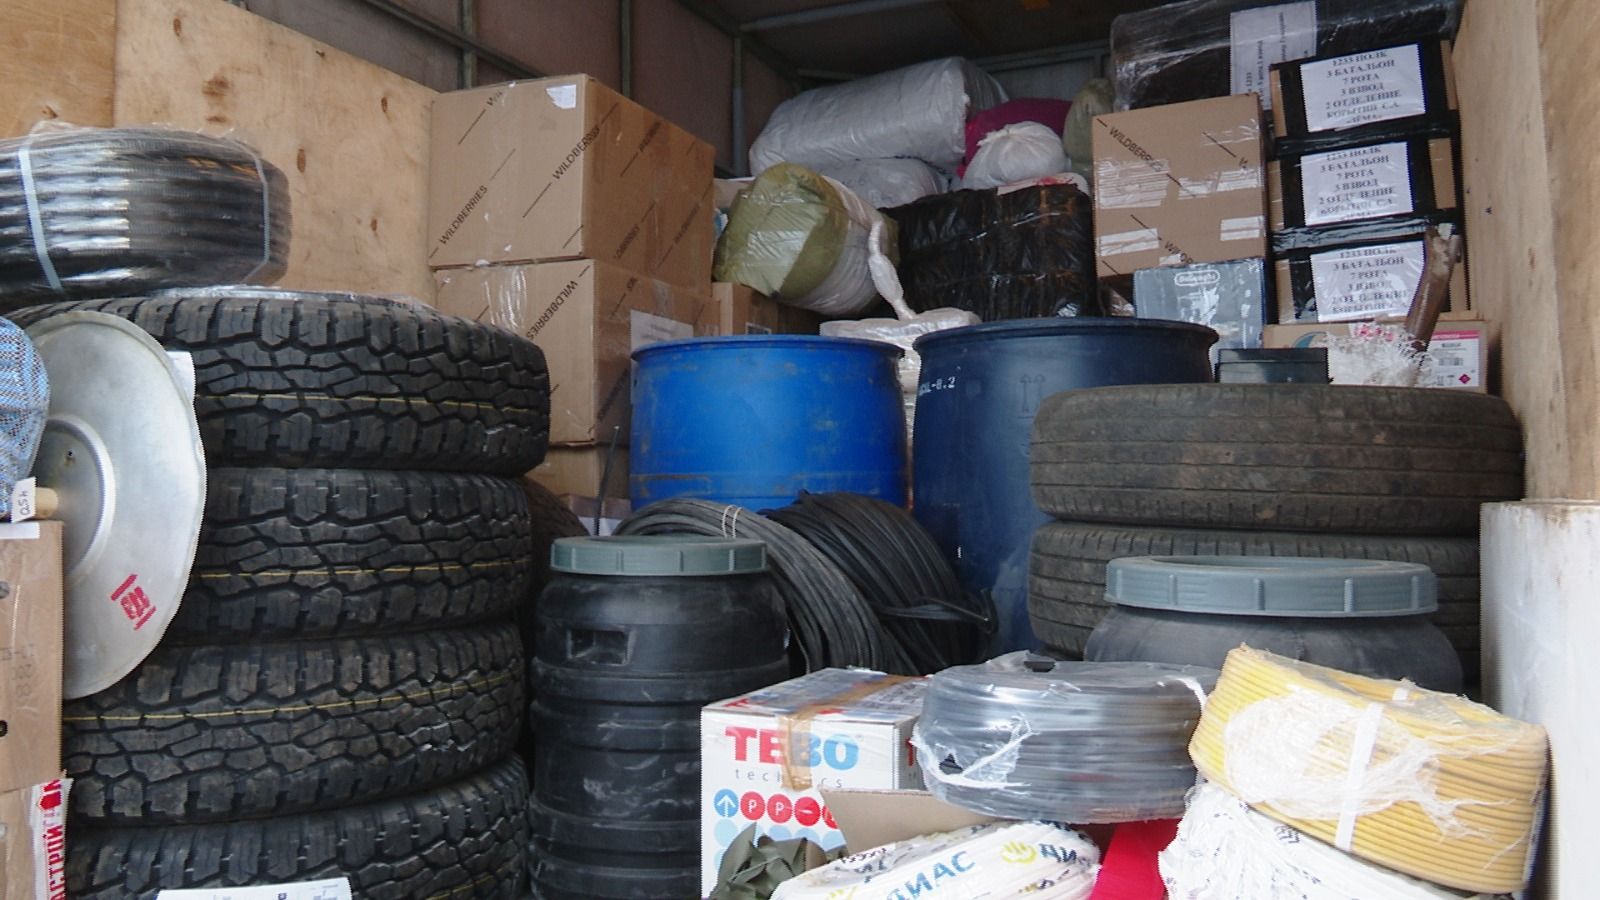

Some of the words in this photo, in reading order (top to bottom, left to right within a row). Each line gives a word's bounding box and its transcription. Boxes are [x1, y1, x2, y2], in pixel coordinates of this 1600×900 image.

[1332, 54, 1354, 66] 1233
[1356, 51, 1388, 62] ПОЛК
[1334, 59, 1395, 76] БАТАЛЬОН
[1350, 73, 1380, 84] РОТА
[1348, 82, 1384, 95] ВЗВОД
[1332, 90, 1401, 107] ОТДЕЛЕНИЕ
[1327, 155, 1390, 171] БАТАЛЬОН
[1344, 169, 1375, 179] РОТА
[1342, 179, 1379, 190] ВЗВОД
[439, 184, 488, 246] WILDBERRIES
[1341, 257, 1405, 271] БАТАЛЬОН
[1358, 270, 1387, 279] РОТА
[1355, 281, 1388, 291] ВЗВО
[526, 279, 578, 341] WILDBERRIES
[724, 726, 860, 771] TEBO
[735, 768, 845, 789] techcs
